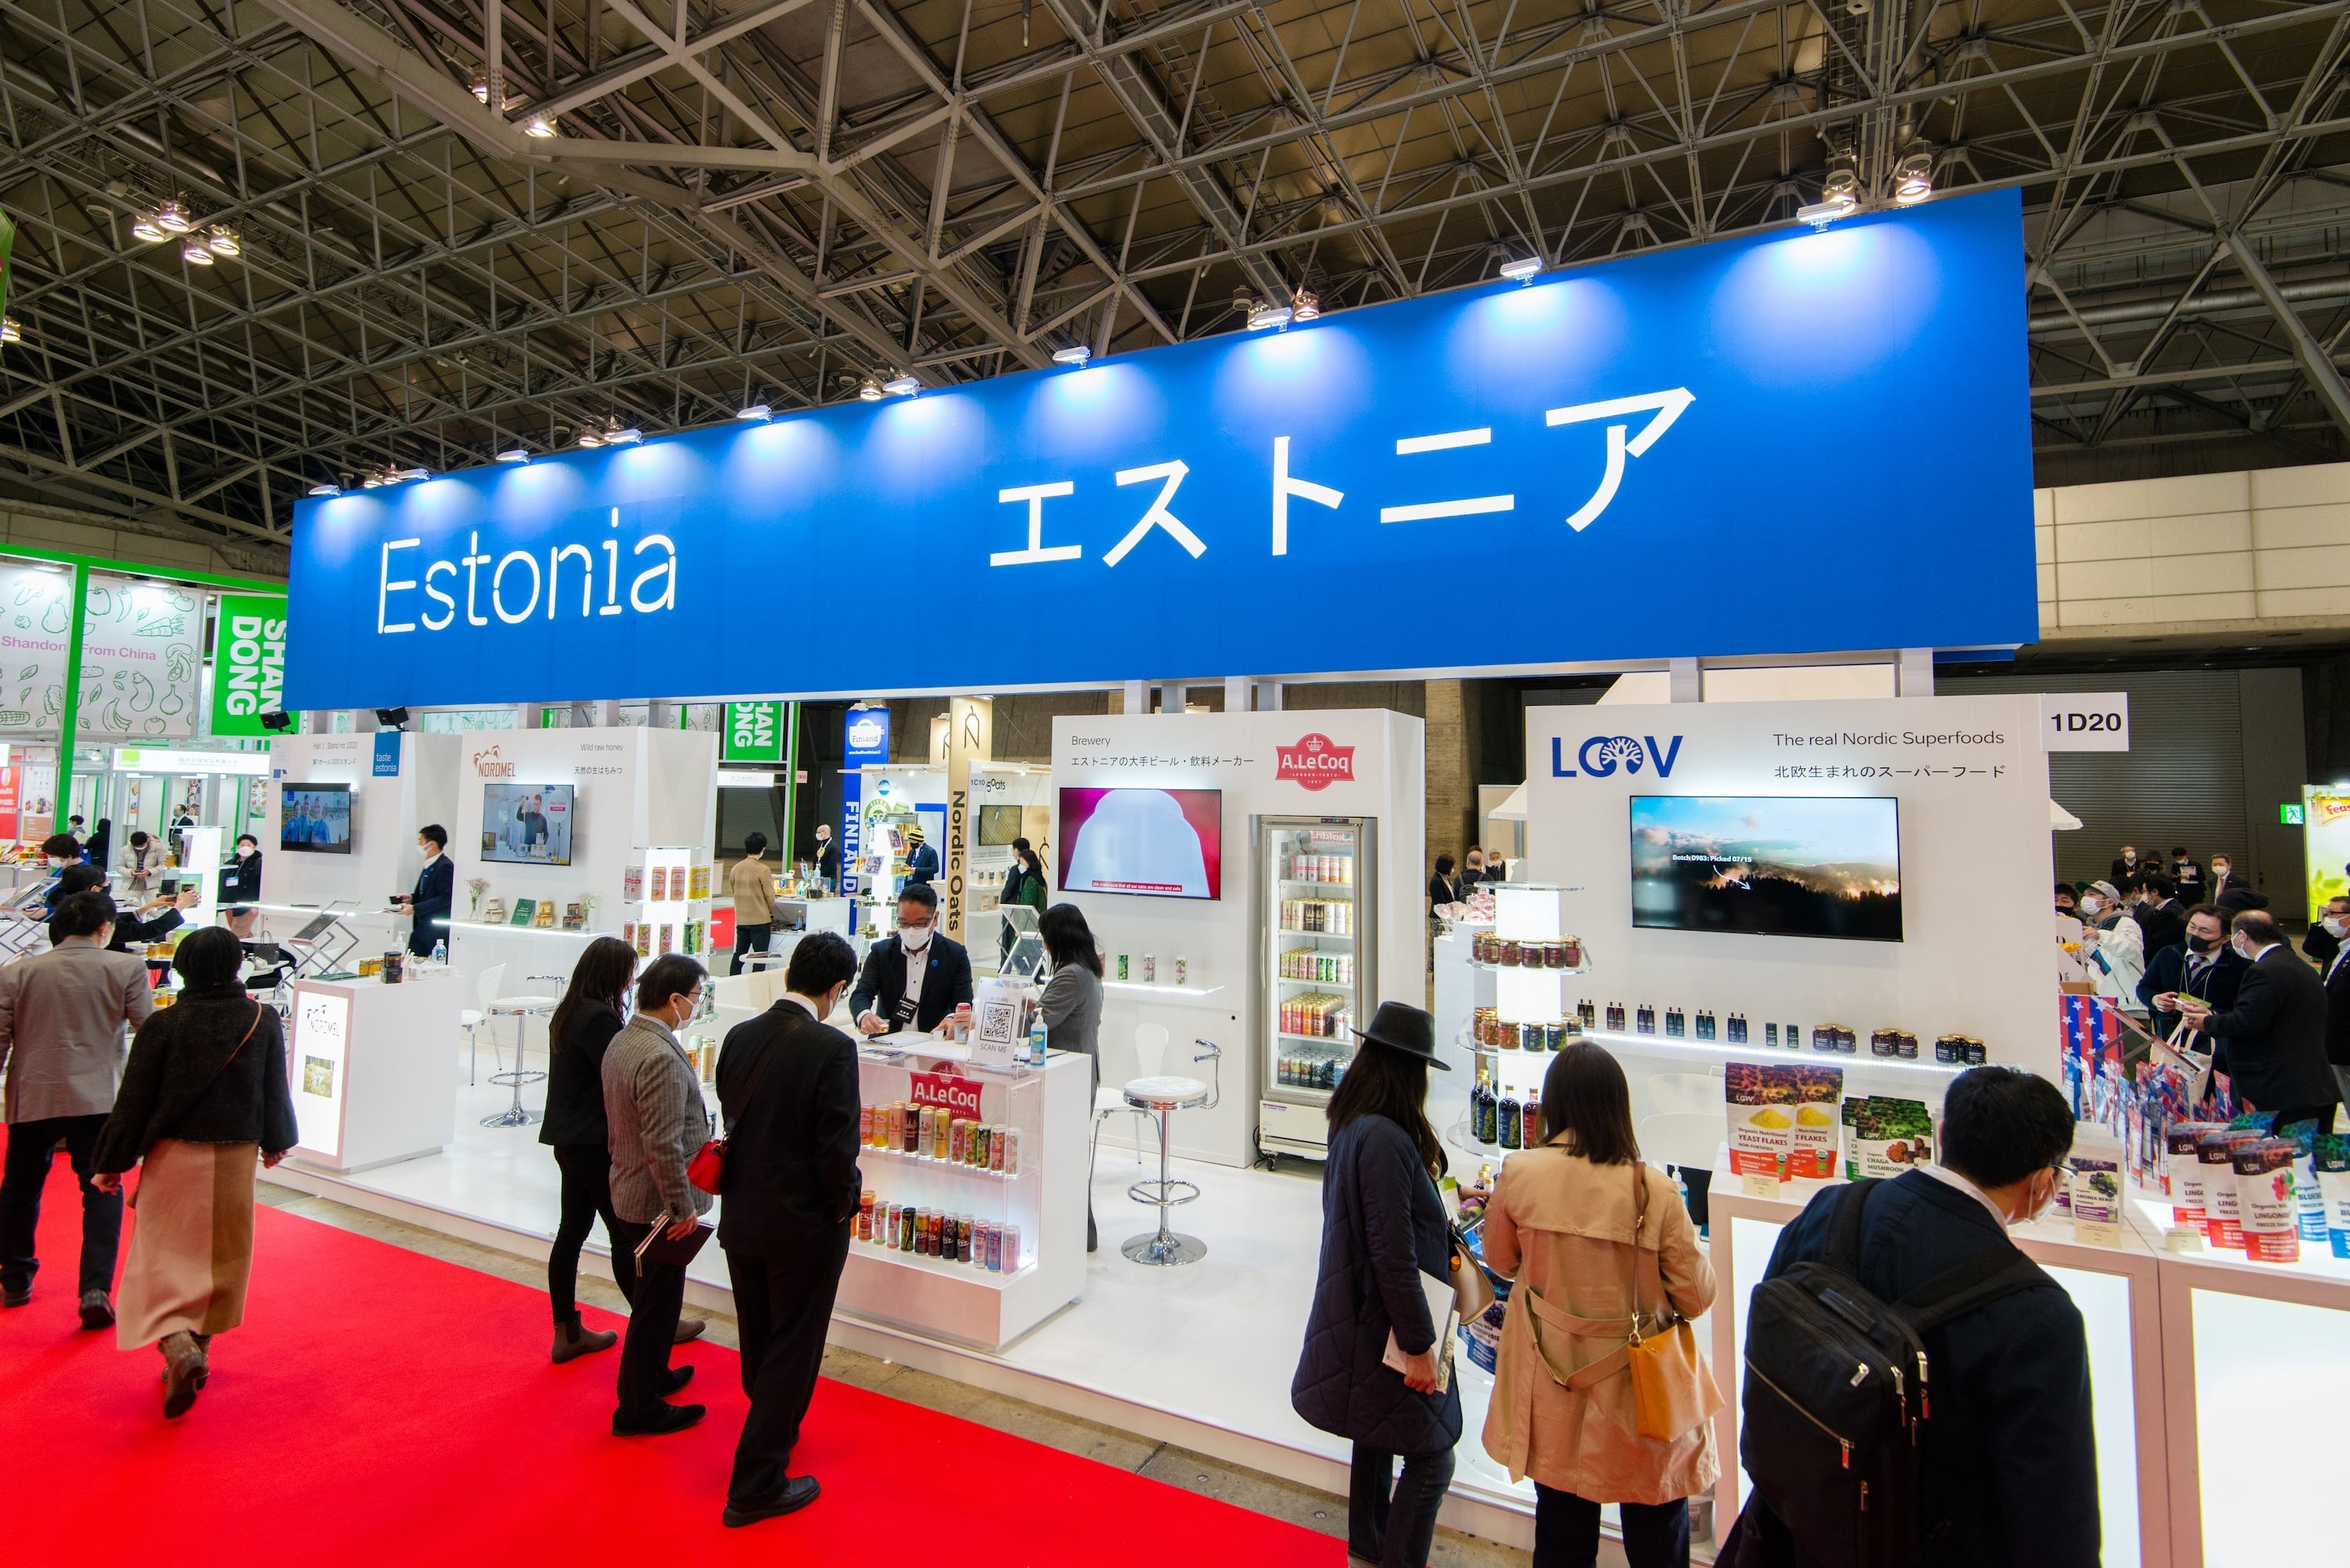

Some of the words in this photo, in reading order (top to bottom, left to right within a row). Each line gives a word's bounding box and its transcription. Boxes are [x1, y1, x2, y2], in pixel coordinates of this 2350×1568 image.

[990, 386, 1696, 568] エストニア
[378, 507, 676, 634] Estonia
[119, 647, 157, 660] China
[226, 616, 262, 715] DONG
[2051, 713, 2122, 732] 1D20
[1072, 735, 1111, 747] Brewery
[1773, 733, 1804, 746] The
[1809, 732, 1837, 746] real
[1843, 732, 1898, 746] Nordic
[1902, 731, 2005, 748] Superfoods
[580, 743, 594, 752] Wild
[606, 743, 624, 753] honey
[376, 753, 392, 762] taste
[1071, 755, 1254, 768] エストニアの大手ビール・飲料メーカー
[1552, 735, 1683, 778] LOOV
[375, 762, 397, 773] estonia
[478, 762, 516, 778] NORDMEL
[574, 766, 623, 775] 天然の生はちみつ
[1774, 764, 2005, 779] 北欧生まれのスーパーフード
[951, 790, 965, 870] Nordic
[843, 801, 860, 891] FINLAND
[949, 875, 964, 931] Oats
[980, 1042, 997, 1052] SCAN
[1738, 1134, 1760, 1143] YEAST
[1762, 1137, 1788, 1147] FLAKES
[1802, 1134, 1828, 1143] FLAKES
[1867, 1164, 1904, 1172] MUSHROOM
